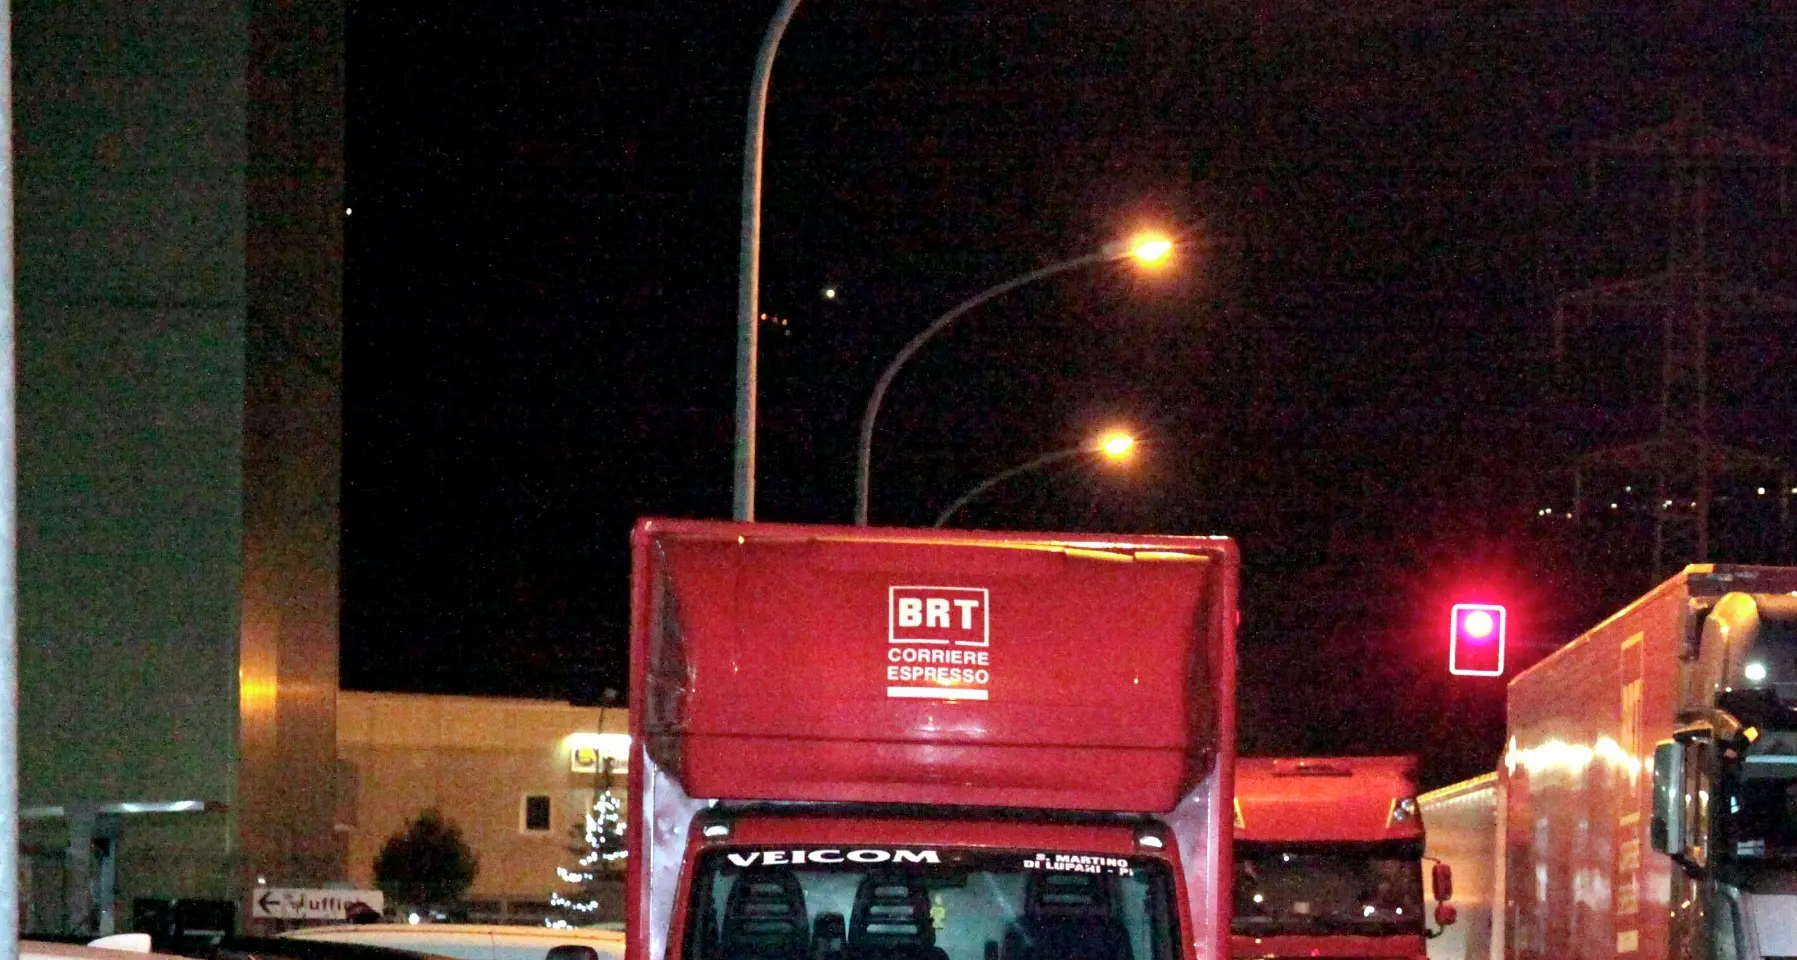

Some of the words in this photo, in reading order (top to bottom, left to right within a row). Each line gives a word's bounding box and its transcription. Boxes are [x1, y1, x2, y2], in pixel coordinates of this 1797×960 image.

[898, 598, 979, 630] BRT
[887, 648, 989, 666] CORRIERE
[887, 666, 989, 684] ESPRESSO
[727, 850, 941, 867] VEICOM
[1023, 860, 1040, 868] DI
[1036, 853, 1050, 861] S.
[1055, 855, 1128, 867] MARTINO
